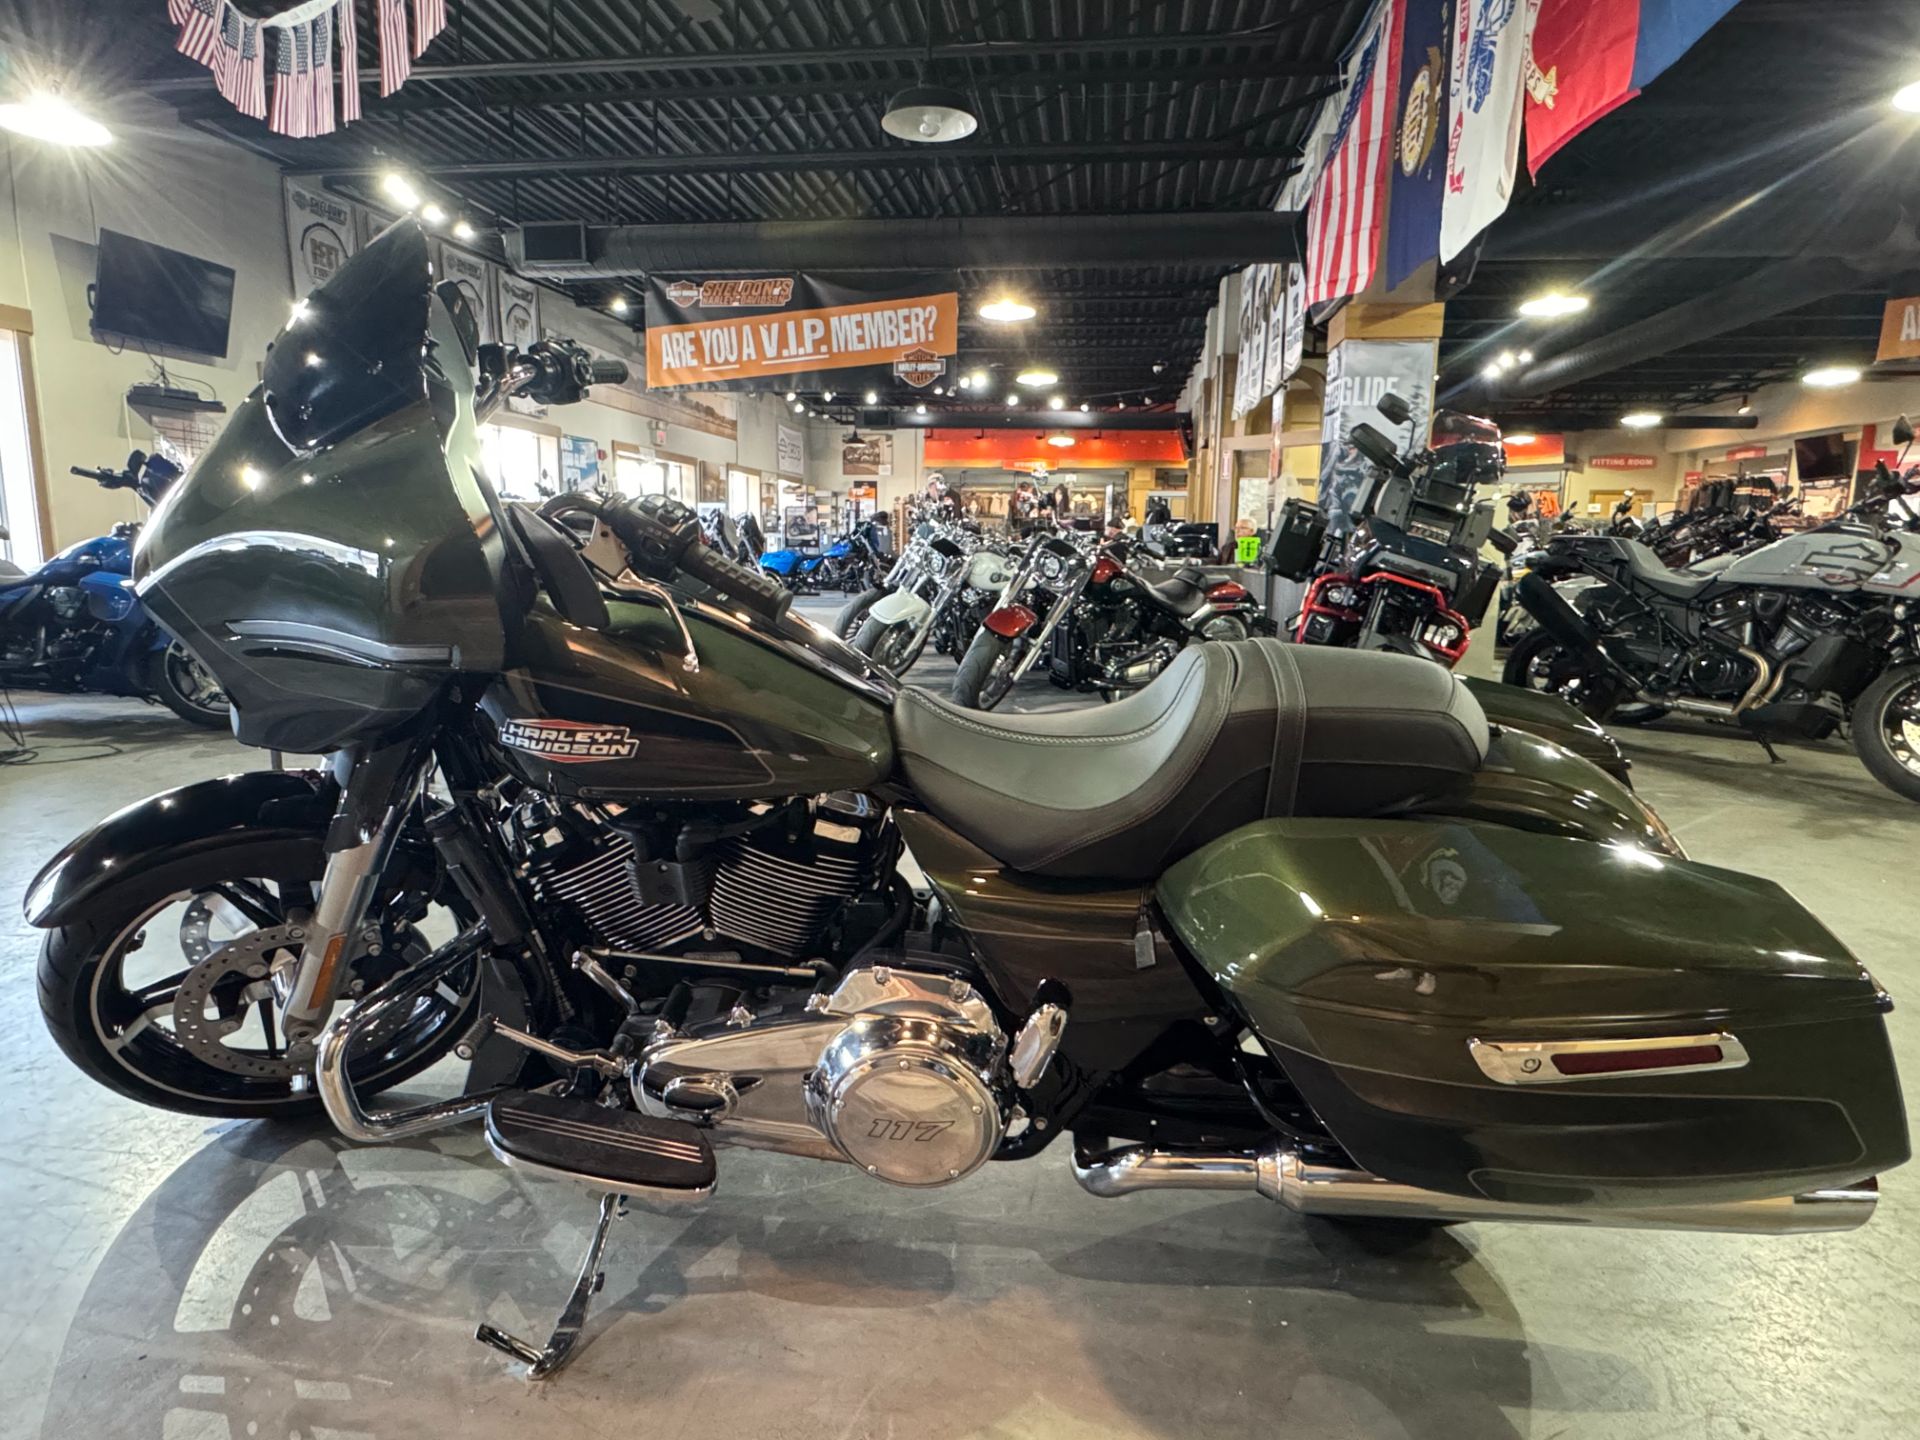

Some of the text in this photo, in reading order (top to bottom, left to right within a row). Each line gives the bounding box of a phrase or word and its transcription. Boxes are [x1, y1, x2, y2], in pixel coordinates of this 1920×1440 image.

[703, 279, 793, 297] SHELDON'S
[661, 305, 938, 370] ARE YOU A V.I.P. MEMBER?
[1592, 458, 1654, 467] FITTING ROOM
[508, 724, 622, 743] HARLEY-
[501, 734, 631, 755] DAVIDSON
[868, 1118, 956, 1142] 117
